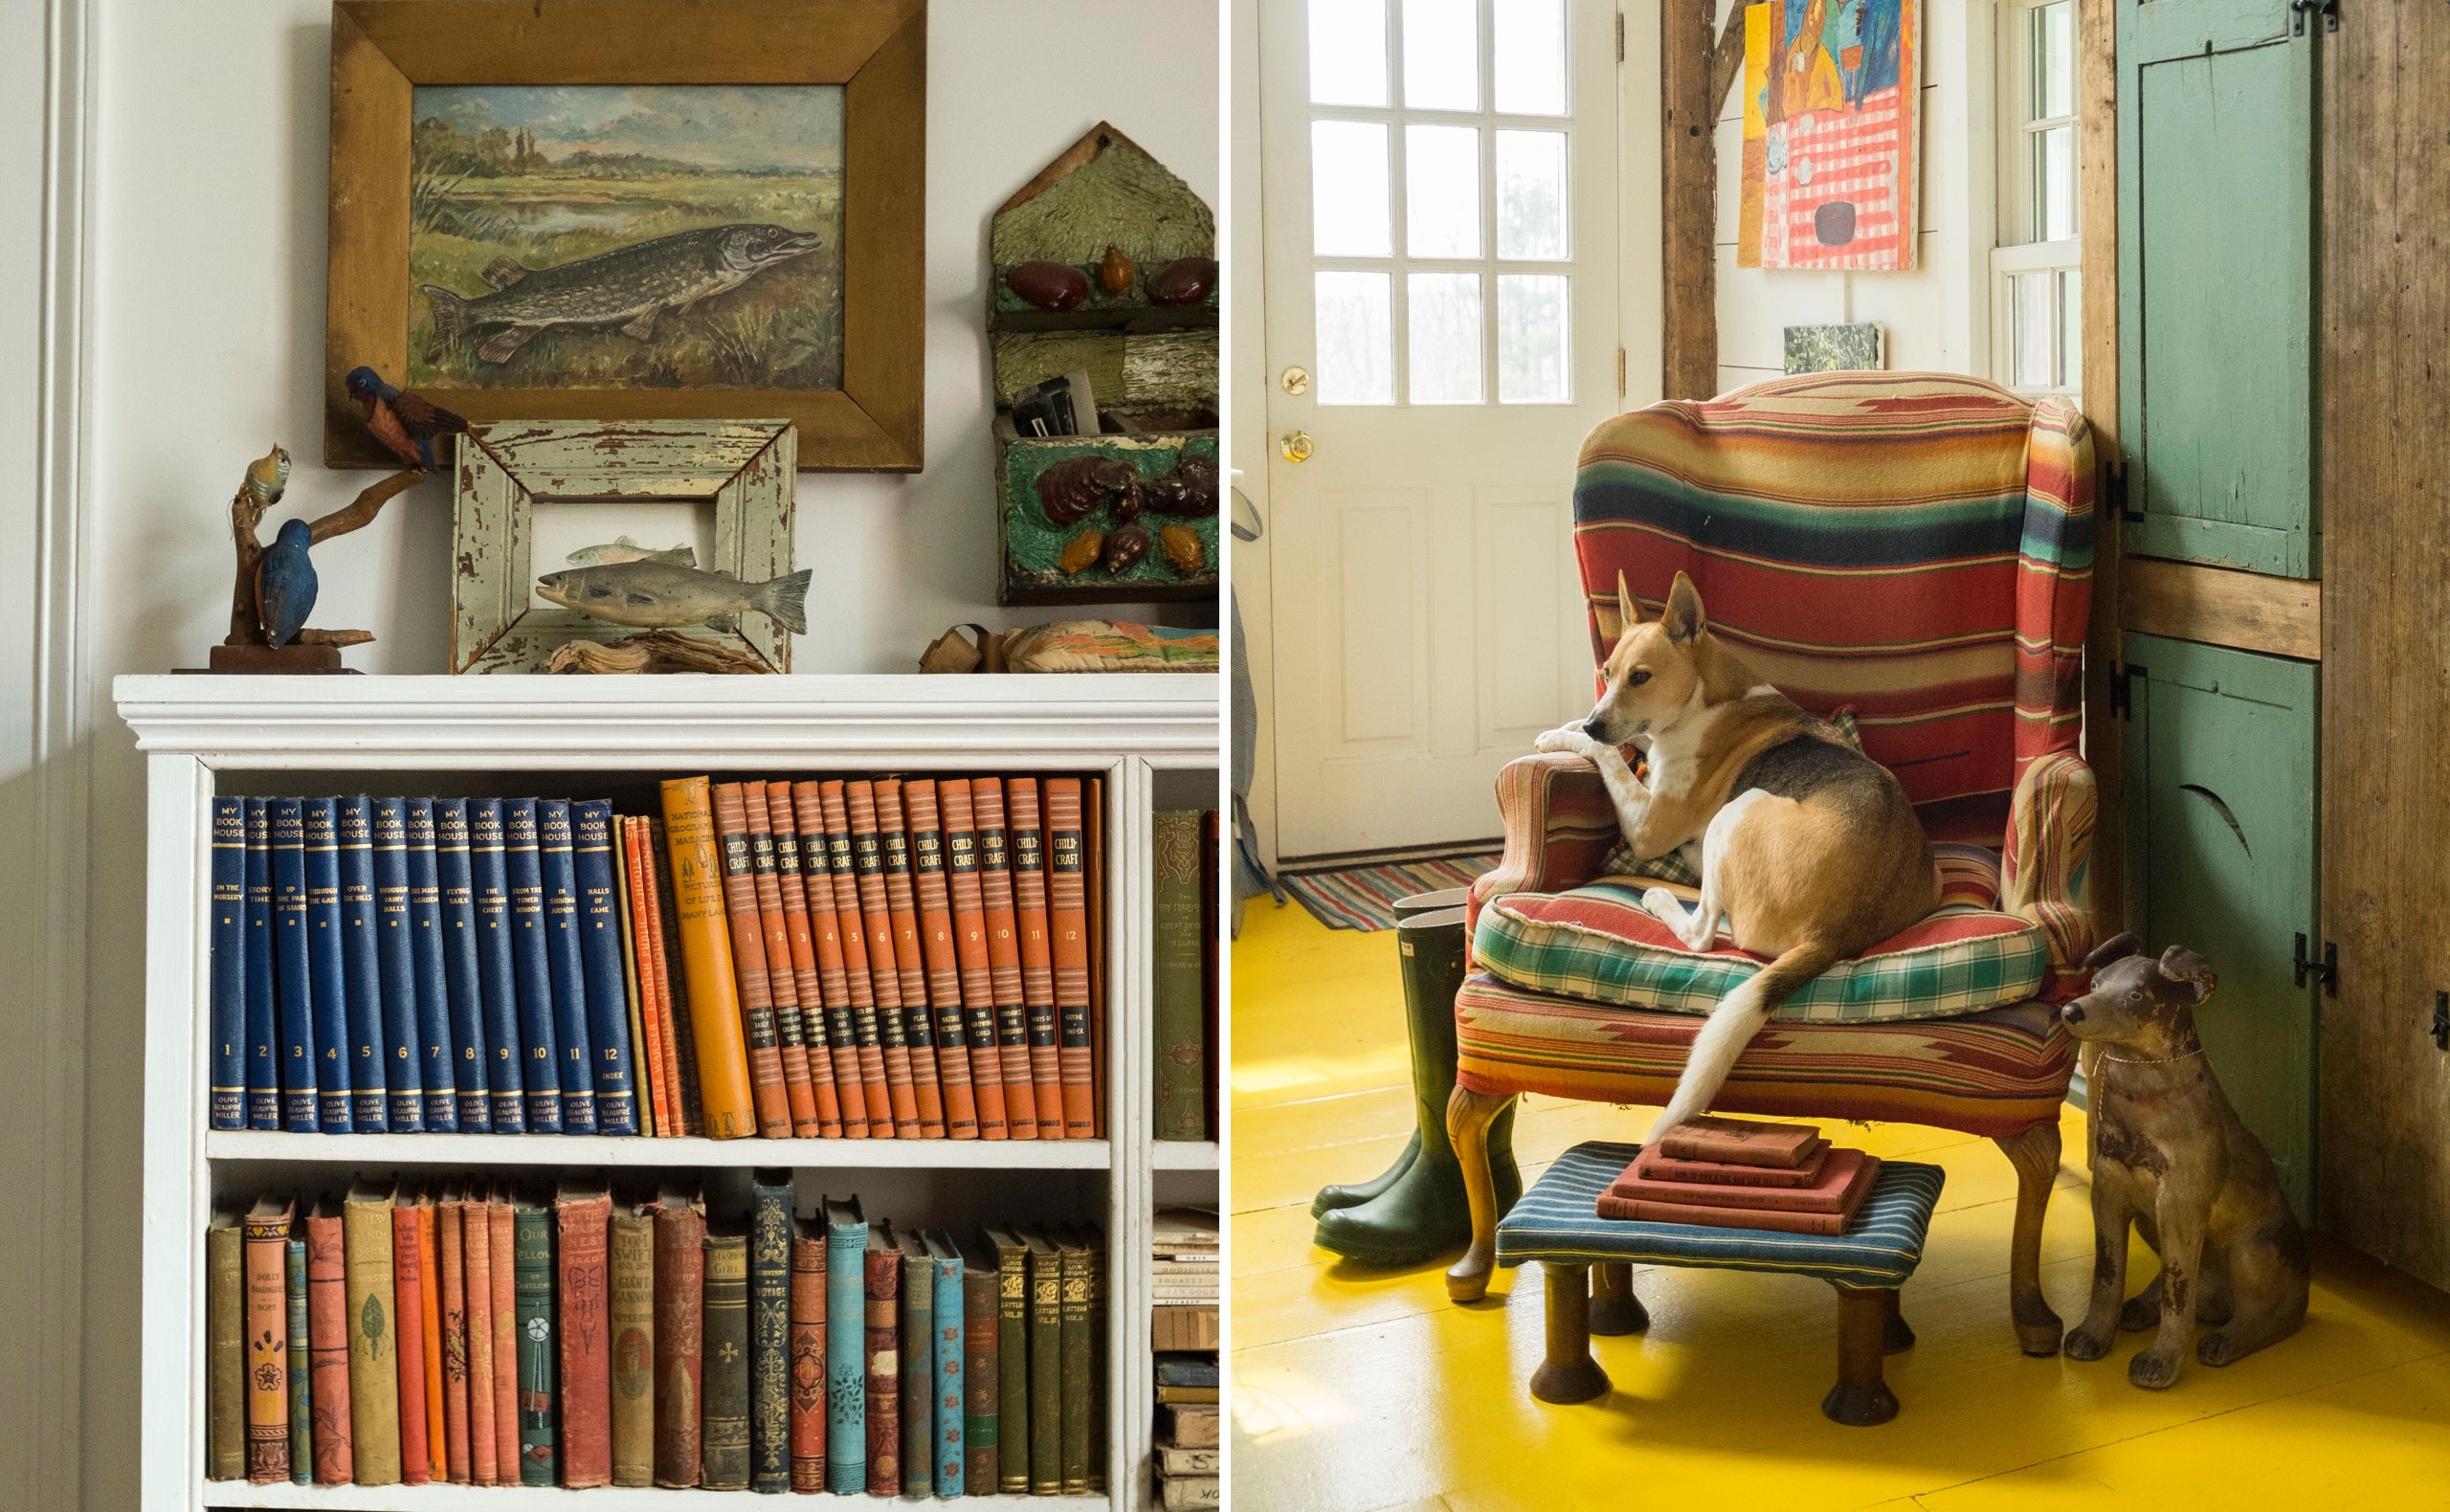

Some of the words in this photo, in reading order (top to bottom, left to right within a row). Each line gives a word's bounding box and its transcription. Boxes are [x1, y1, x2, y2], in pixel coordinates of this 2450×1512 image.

[441, 821, 466, 830] BOOK
[475, 821, 501, 830] BOOK
[544, 821, 569, 830] BOOK
[214, 829, 245, 837] HOUSE
[275, 830, 304, 838] HOUSE
[305, 832, 335, 840] HOUSE
[375, 831, 405, 839] HOUSE
[439, 832, 469, 840] HOUSE
[507, 832, 537, 840] HOUSE
[634, 857, 644, 911] SCHOOLS
[682, 911, 706, 920] MANY
[748, 933, 752, 942] 1
[777, 932, 783, 941] 2
[800, 933, 807, 942] 3
[827, 932, 834, 941] 4
[852, 933, 858, 942] 5
[879, 933, 885, 942] 6
[905, 930, 912, 940] 7
[938, 932, 945, 941] 8
[971, 932, 977, 941] 9
[997, 929, 1009, 939] 10
[1032, 930, 1040, 940] 11
[1066, 931, 1076, 940] 12
[639, 922, 651, 958] PUBLIC
[652, 927, 662, 971] HOUSE
[643, 963, 657, 1011] ENGLISH
[225, 1044, 230, 1056] 1
[259, 1046, 267, 1056] 2
[294, 1046, 302, 1057] 3
[362, 1046, 370, 1056] 5
[398, 1047, 407, 1058] 6
[432, 1047, 440, 1057] 7
[650, 1023, 661, 1073] WARNER
[327, 1049, 337, 1059] 4
[465, 1048, 475, 1059] 8
[501, 1049, 508, 1059] 9
[533, 1048, 546, 1059] 10
[570, 1048, 580, 1059] 11
[605, 1049, 617, 1059] 12
[654, 1079, 664, 1101] REX
[520, 1228, 548, 1241] OUR
[620, 1234, 648, 1247] TOM
[714, 1264, 740, 1274] GIRL
[756, 1287, 787, 1297] VOYAGE
